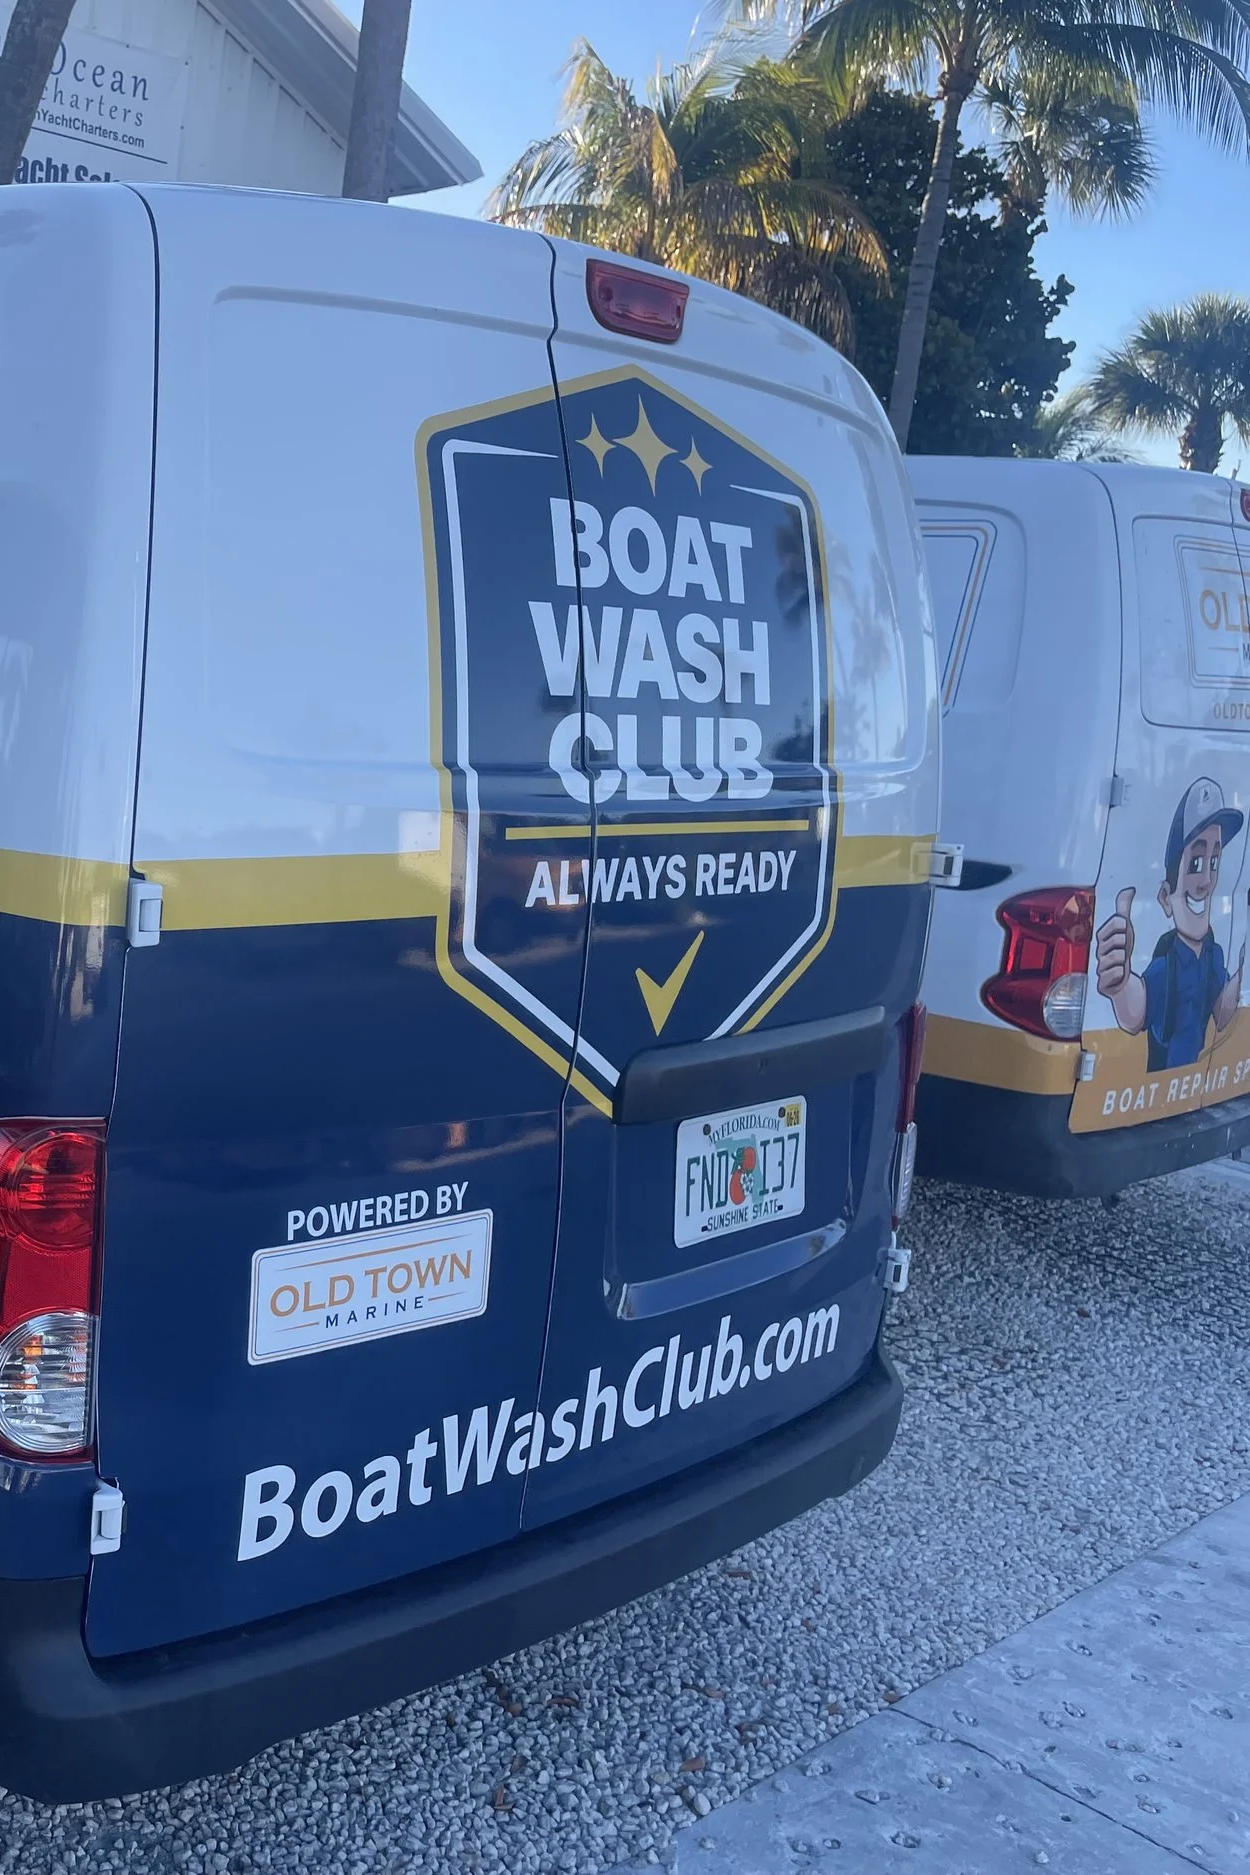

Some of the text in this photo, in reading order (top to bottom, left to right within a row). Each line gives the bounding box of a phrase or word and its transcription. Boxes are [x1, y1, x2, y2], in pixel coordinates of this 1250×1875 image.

[14, 156, 69, 184] acht
[550, 497, 753, 604] BOAT
[528, 601, 771, 706] WASH
[549, 711, 774, 804] CLUB
[524, 850, 797, 908] ALWAYS READY
[1102, 1083, 1160, 1116] BOAT
[1167, 1066, 1228, 1103] REPAIR
[707, 1114, 782, 1146] MYFLORIDA.COM
[287, 1181, 469, 1241] POWERED BY
[686, 1150, 729, 1217] FND
[707, 1198, 778, 1232] SUNSHINE STATE
[270, 1249, 472, 1317] OLD TOWN
[325, 1296, 425, 1329] MARINE
[236, 1304, 840, 1563] BoatWashClub.com
